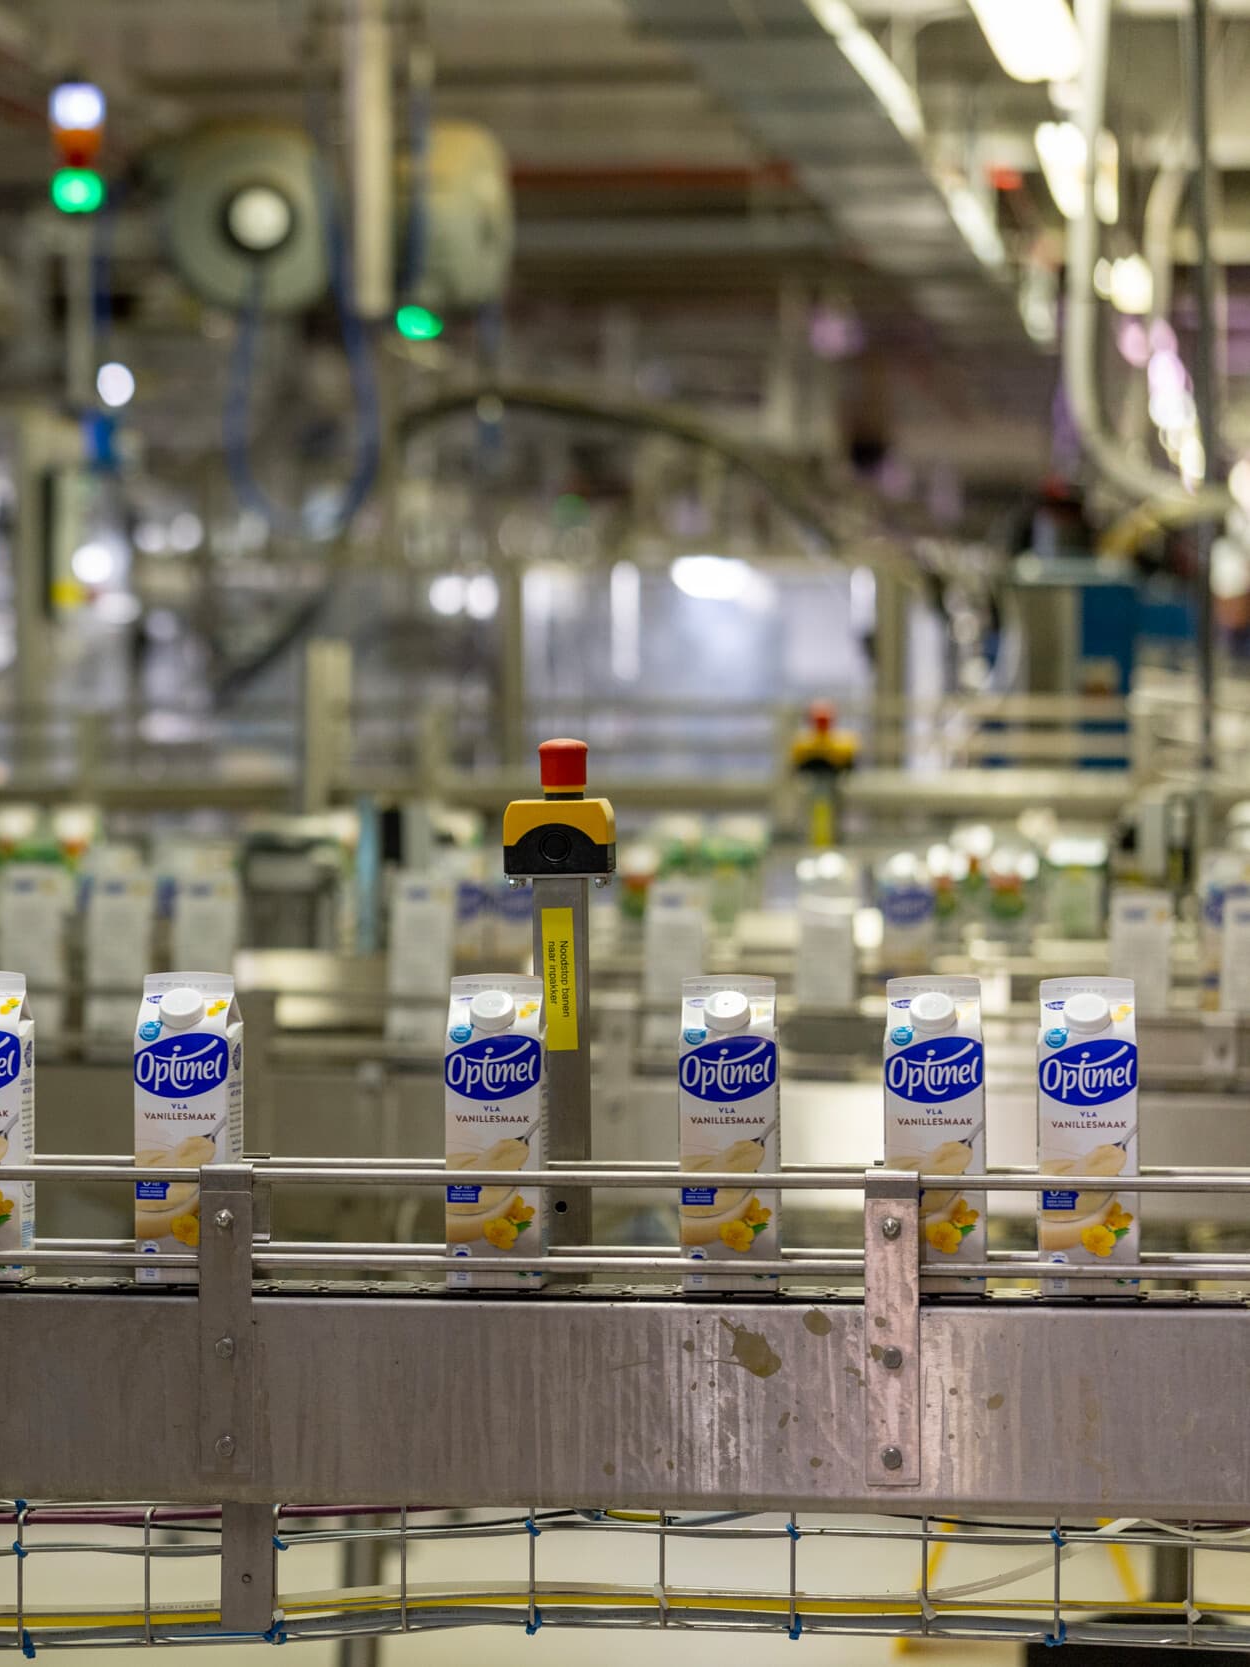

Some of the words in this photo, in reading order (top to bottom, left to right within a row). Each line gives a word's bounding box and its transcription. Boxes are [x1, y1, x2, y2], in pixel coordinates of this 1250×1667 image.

[547, 941, 556, 962] naar
[559, 940, 569, 985] Noodstop
[548, 964, 558, 1005] inpakker
[561, 988, 570, 1018] banen
[136, 1037, 223, 1092] Optimel
[448, 1040, 536, 1095] Optimel
[682, 1040, 771, 1096] Optimel
[888, 1042, 979, 1098] Optimel
[1042, 1044, 1134, 1100] Optimel
[144, 1112, 217, 1122] VANILLESMAAK
[455, 1114, 530, 1124] VANILLESMAAK
[483, 1105, 501, 1113] VLA
[718, 1106, 736, 1114] VLA
[925, 1108, 943, 1116] VLA
[690, 1116, 766, 1126] VANILLESMAAK
[897, 1117, 973, 1126] VANILLESMAAK
[1051, 1120, 1128, 1129] VANILLESMAAK
